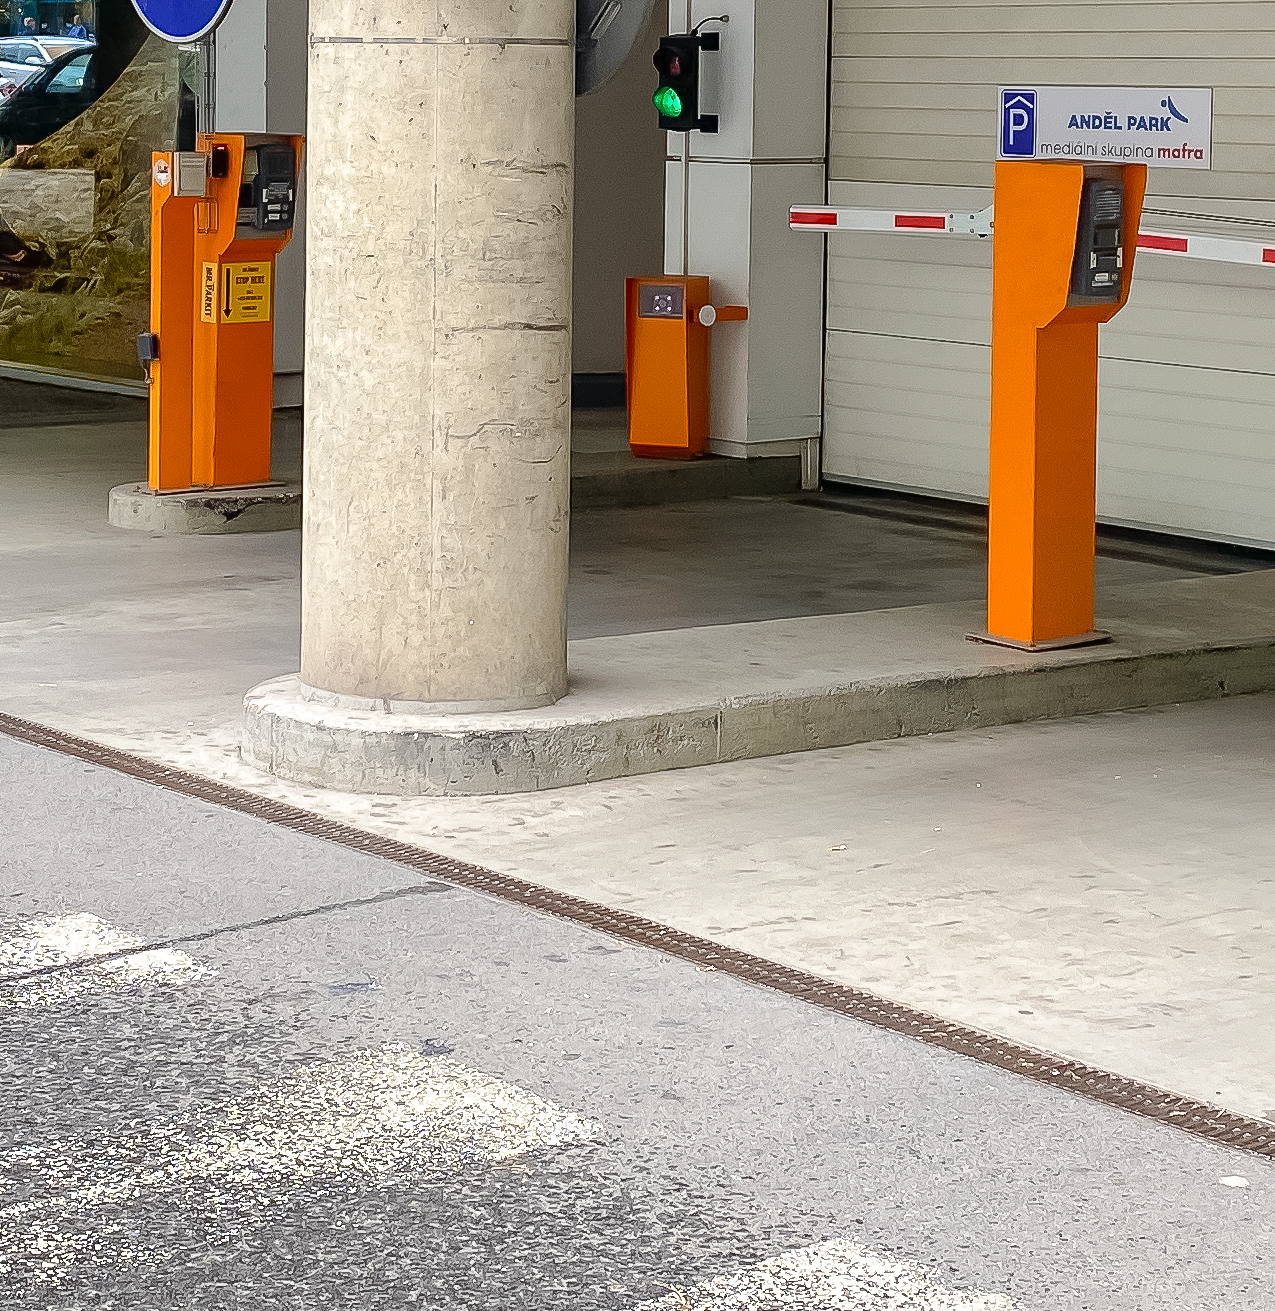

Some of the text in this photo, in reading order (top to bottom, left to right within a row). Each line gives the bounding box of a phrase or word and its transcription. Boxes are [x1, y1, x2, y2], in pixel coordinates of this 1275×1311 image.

[1008, 108, 1029, 146] P
[1067, 110, 1172, 132] ANDĚL PARK
[1040, 141, 1204, 161] mediální skupina mafra
